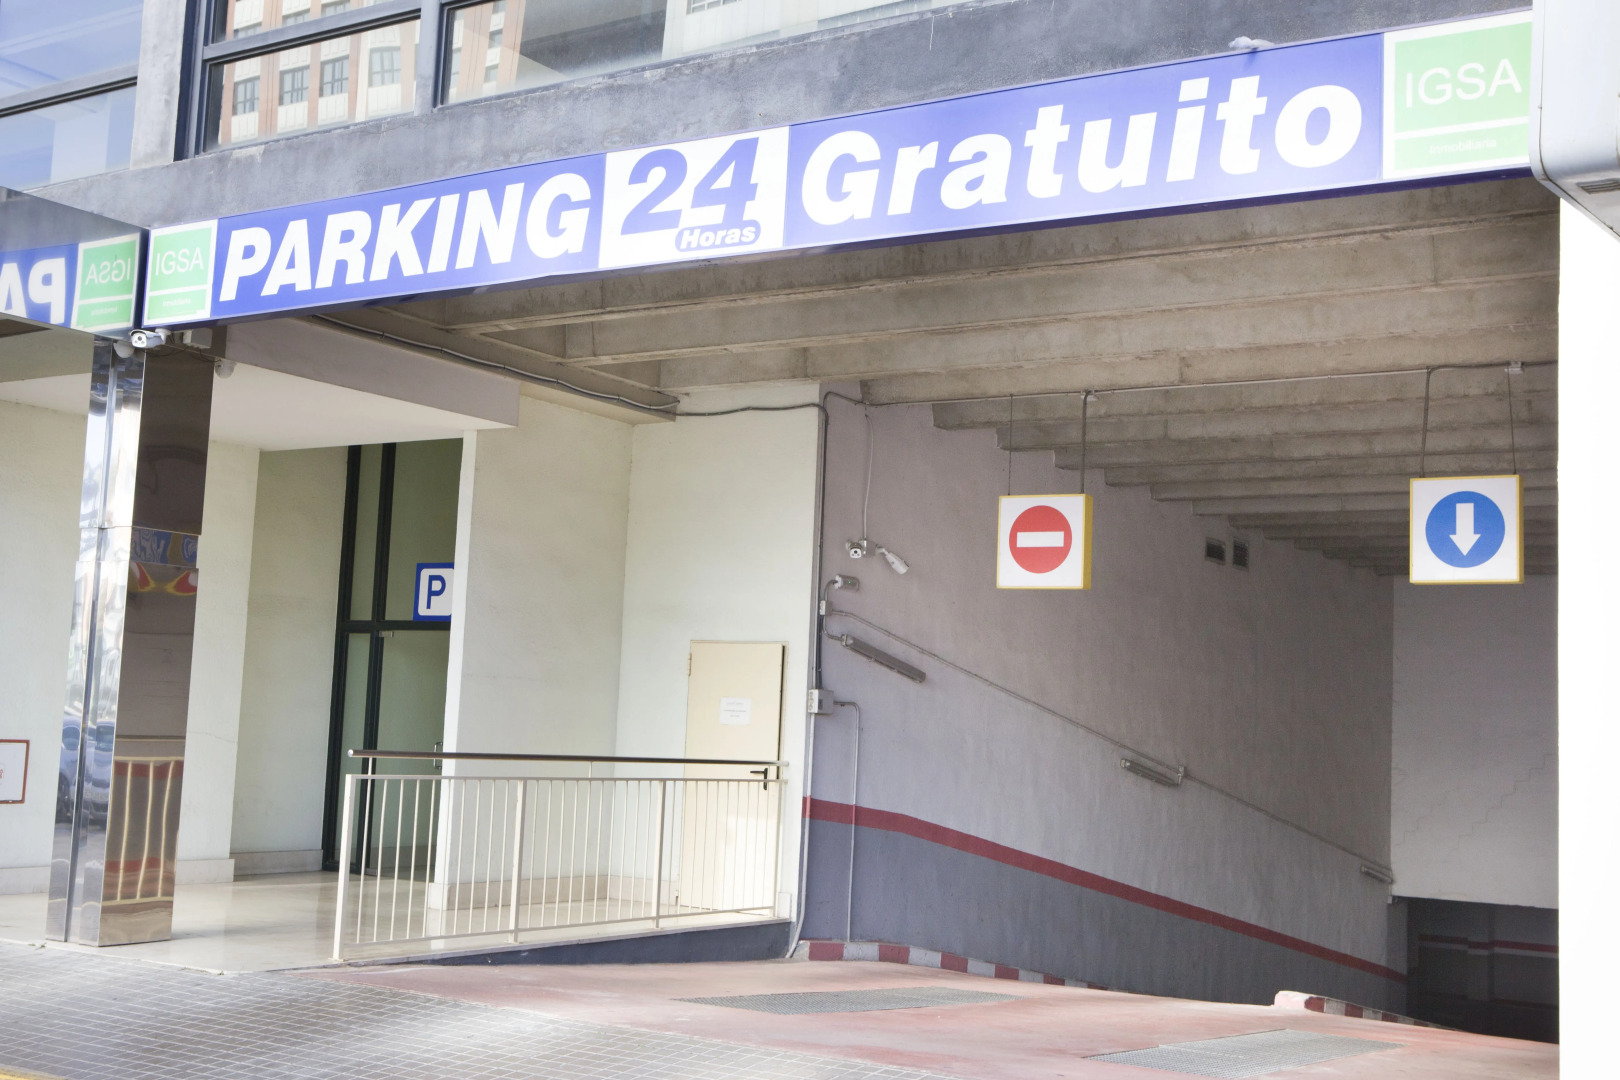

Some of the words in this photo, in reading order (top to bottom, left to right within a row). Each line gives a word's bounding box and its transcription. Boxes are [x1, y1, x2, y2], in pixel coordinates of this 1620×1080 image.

[1406, 58, 1522, 108] IGSA
[219, 173, 591, 301] PARKING
[620, 137, 759, 235] 24
[802, 74, 1362, 225] Gratuito
[680, 226, 756, 249] Horas
[155, 246, 204, 276] IGSA
[426, 574, 446, 609] P
